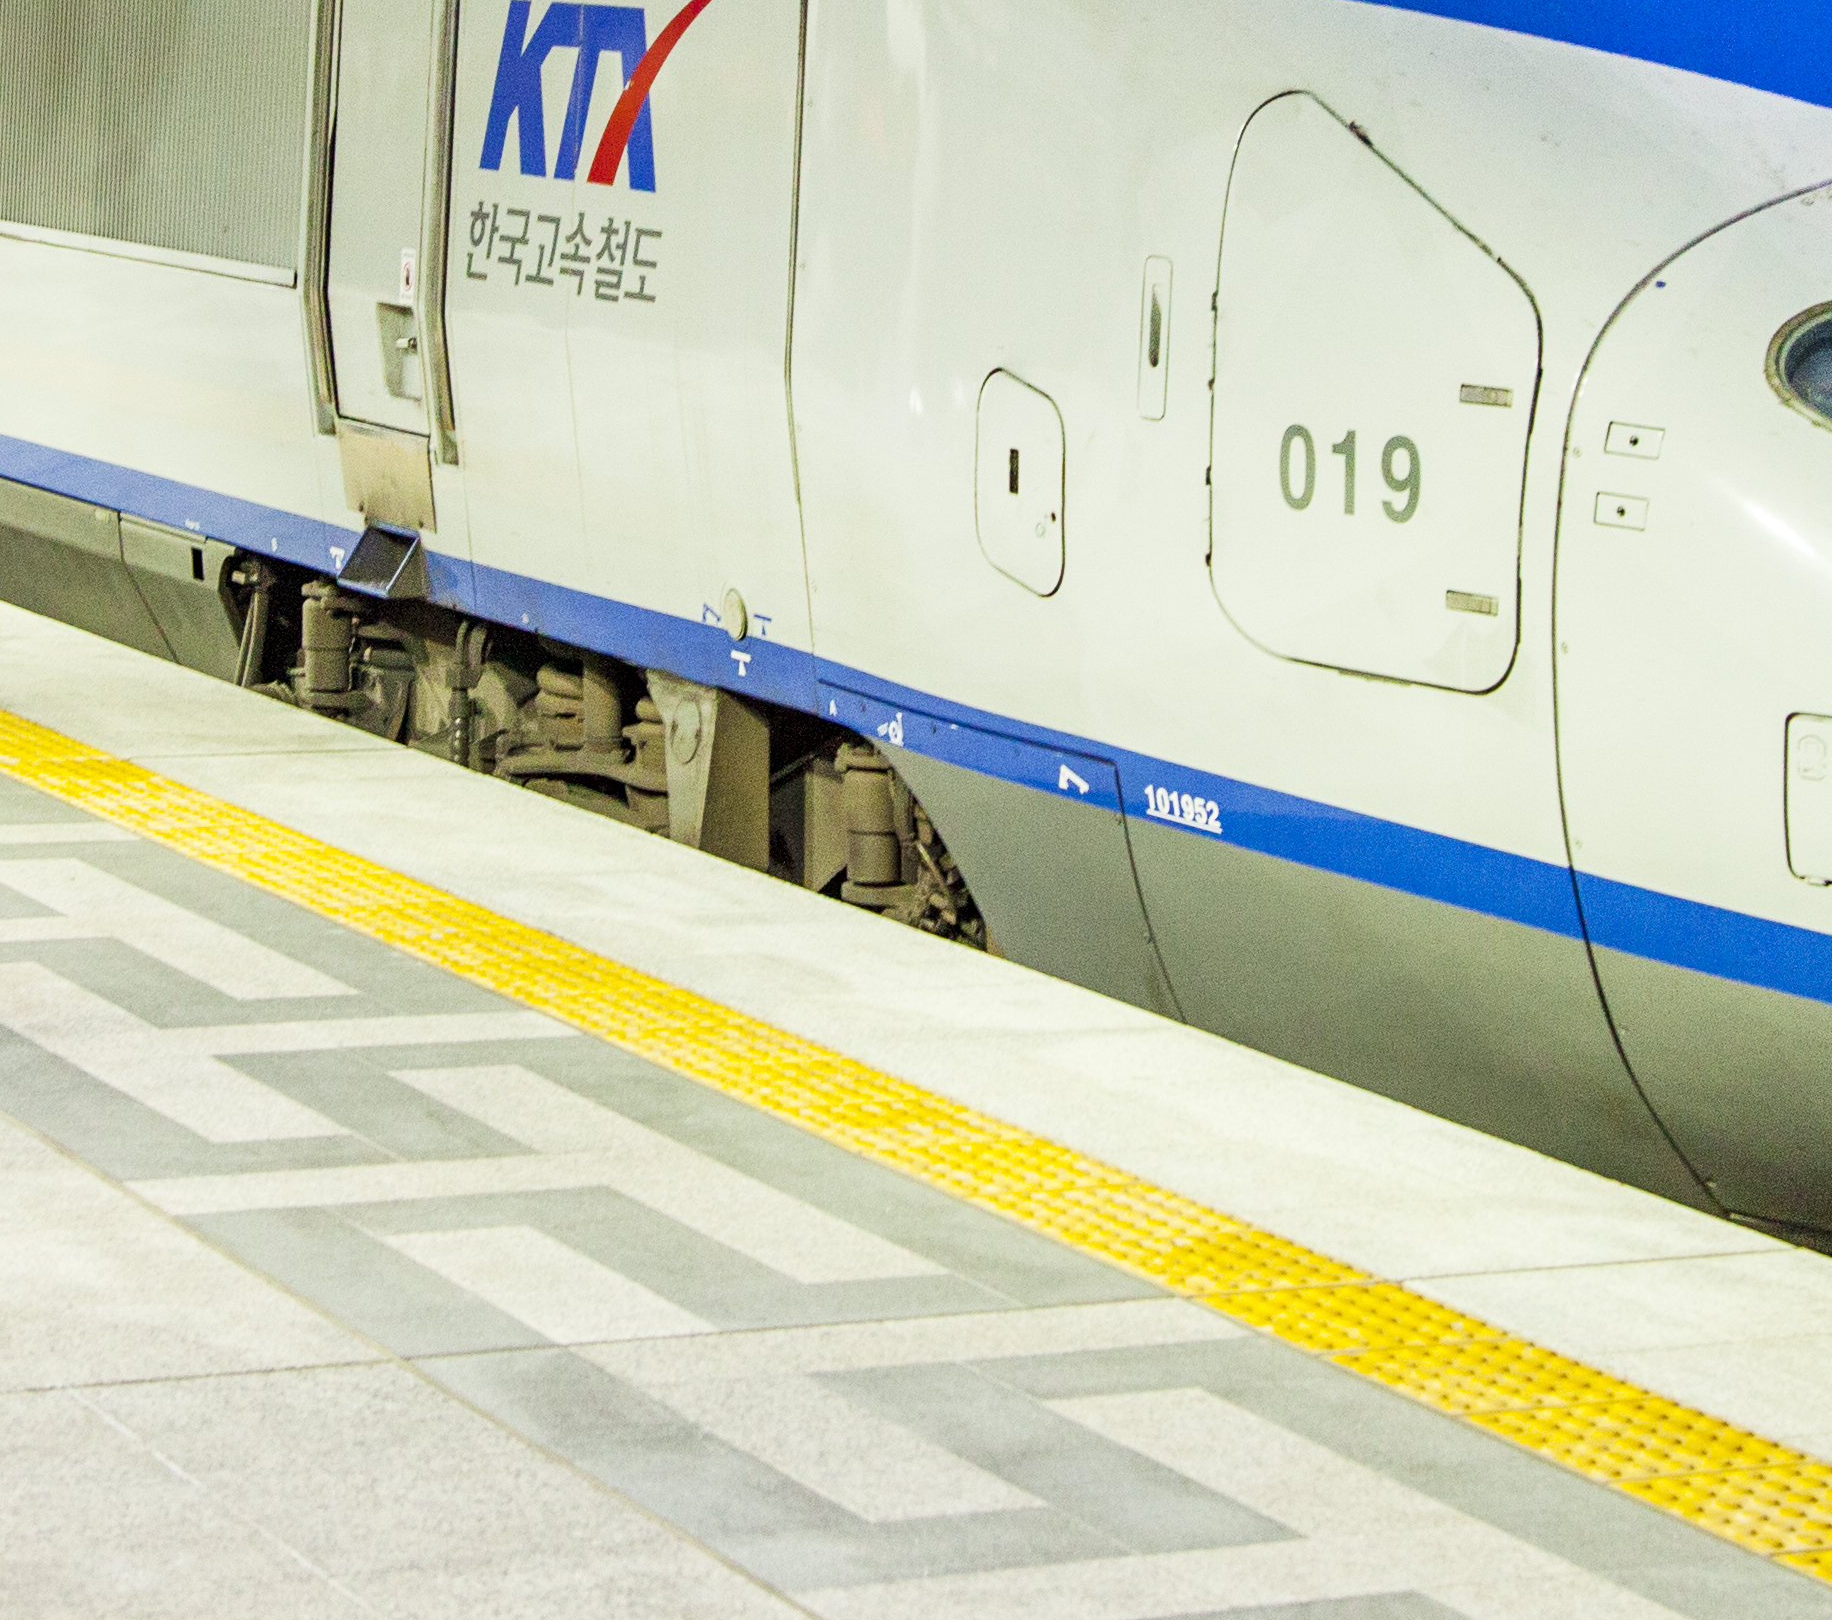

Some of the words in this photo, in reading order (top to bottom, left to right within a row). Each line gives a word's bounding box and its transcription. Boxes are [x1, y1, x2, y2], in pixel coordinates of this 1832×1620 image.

[466, 201, 662, 304] 한국고속철도
[1280, 424, 1421, 523] 019
[1144, 784, 1223, 830] 101952
